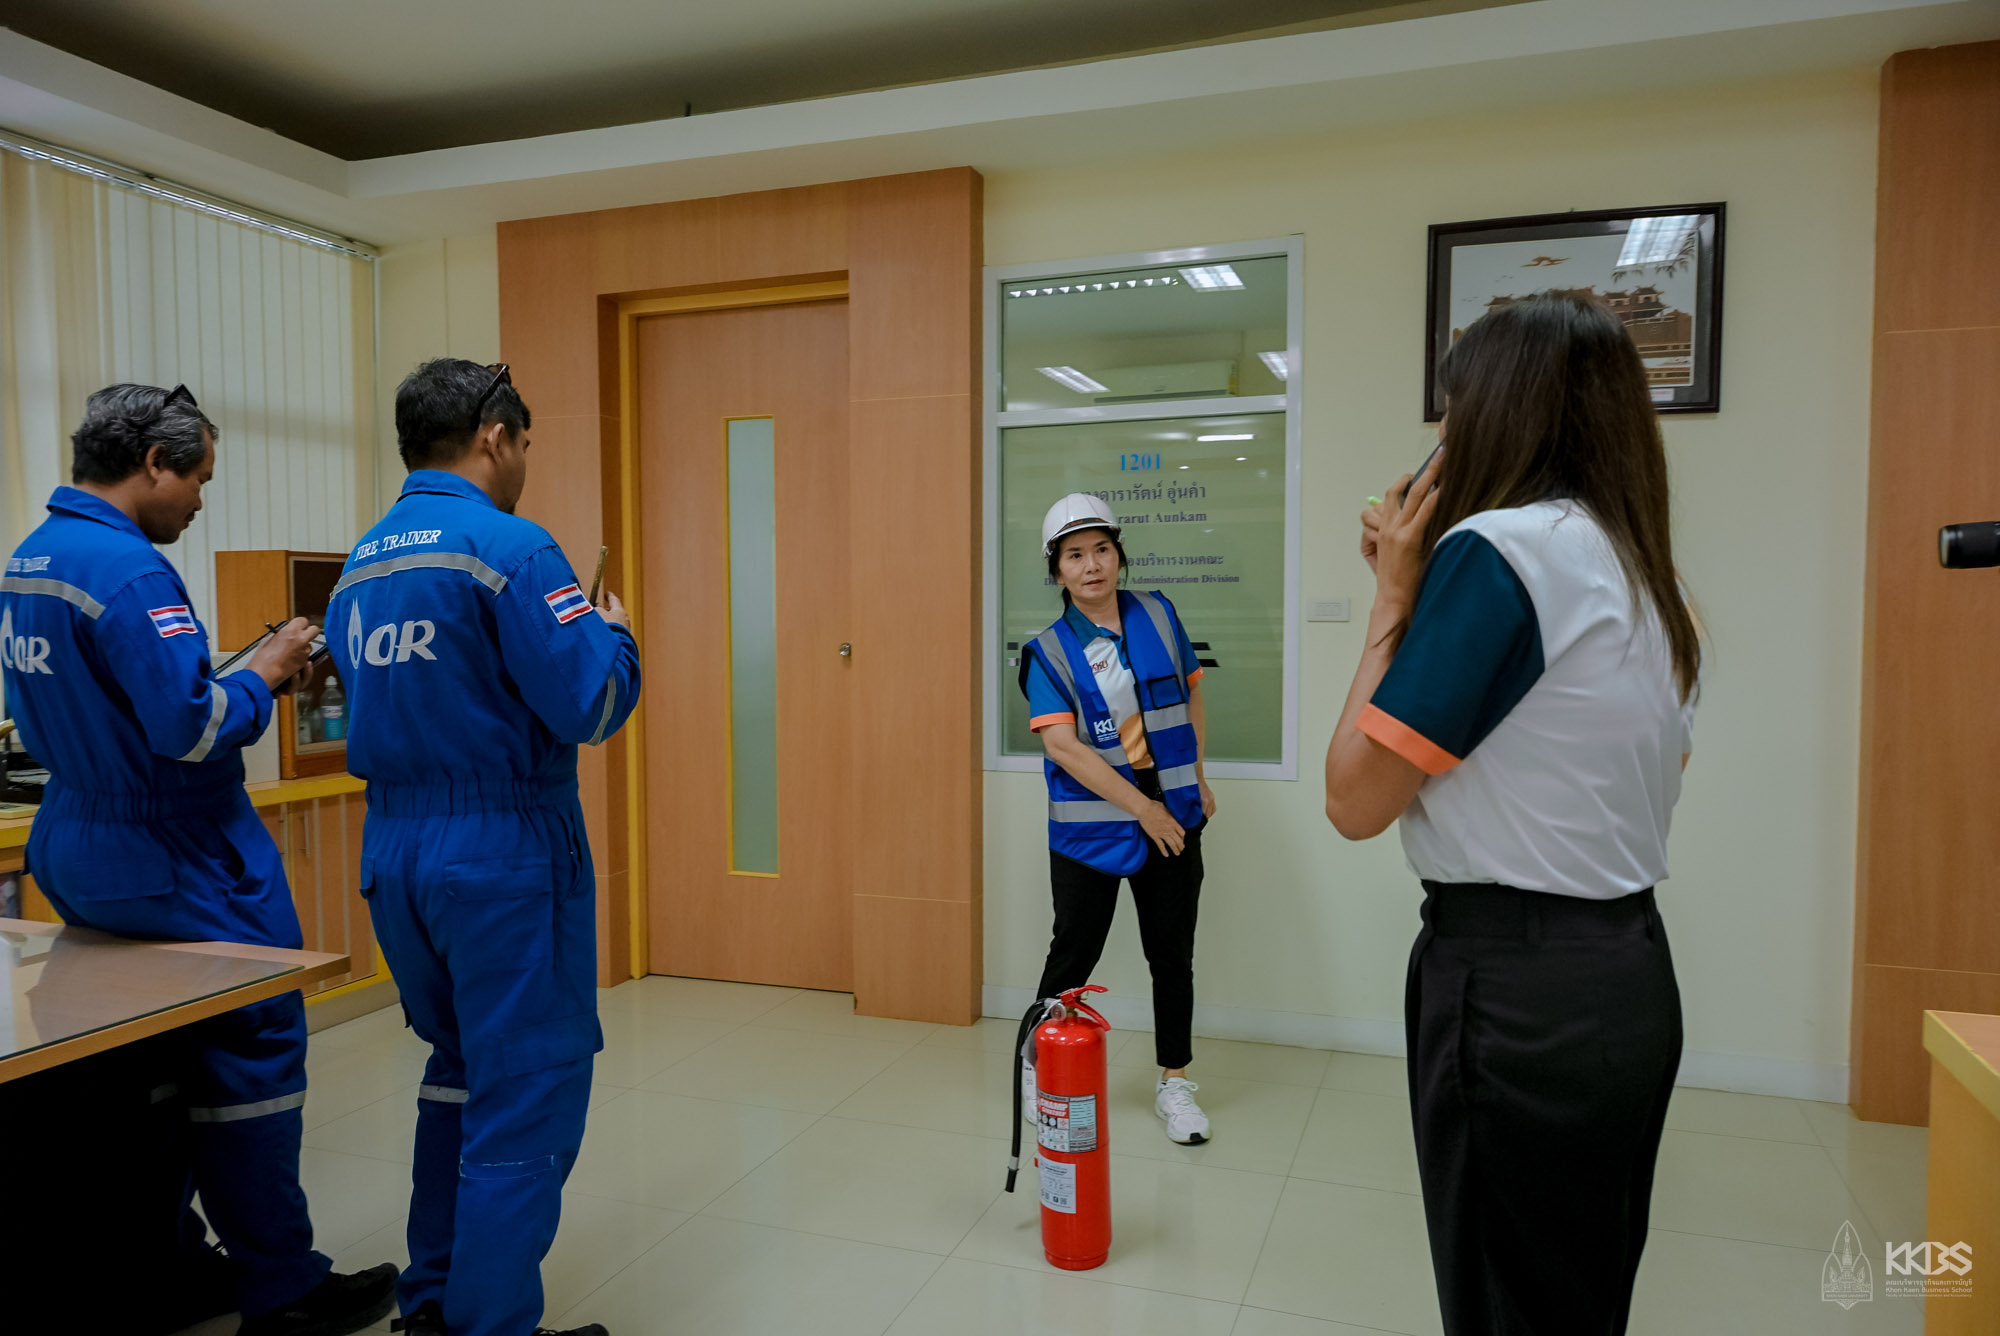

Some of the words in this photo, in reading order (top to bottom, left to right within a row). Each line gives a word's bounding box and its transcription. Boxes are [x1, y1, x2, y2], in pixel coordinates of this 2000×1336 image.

[1120, 453, 1161, 471] 1201
[1117, 513, 1149, 524] rarut
[1153, 511, 1207, 523] Aunkam
[354, 540, 379, 561] FIRE
[382, 530, 442, 552] TRAINER
[1130, 576, 1199, 585] Administration
[1201, 575, 1240, 584] Division
[364, 619, 438, 666] OR
[15, 636, 54, 674] OR
